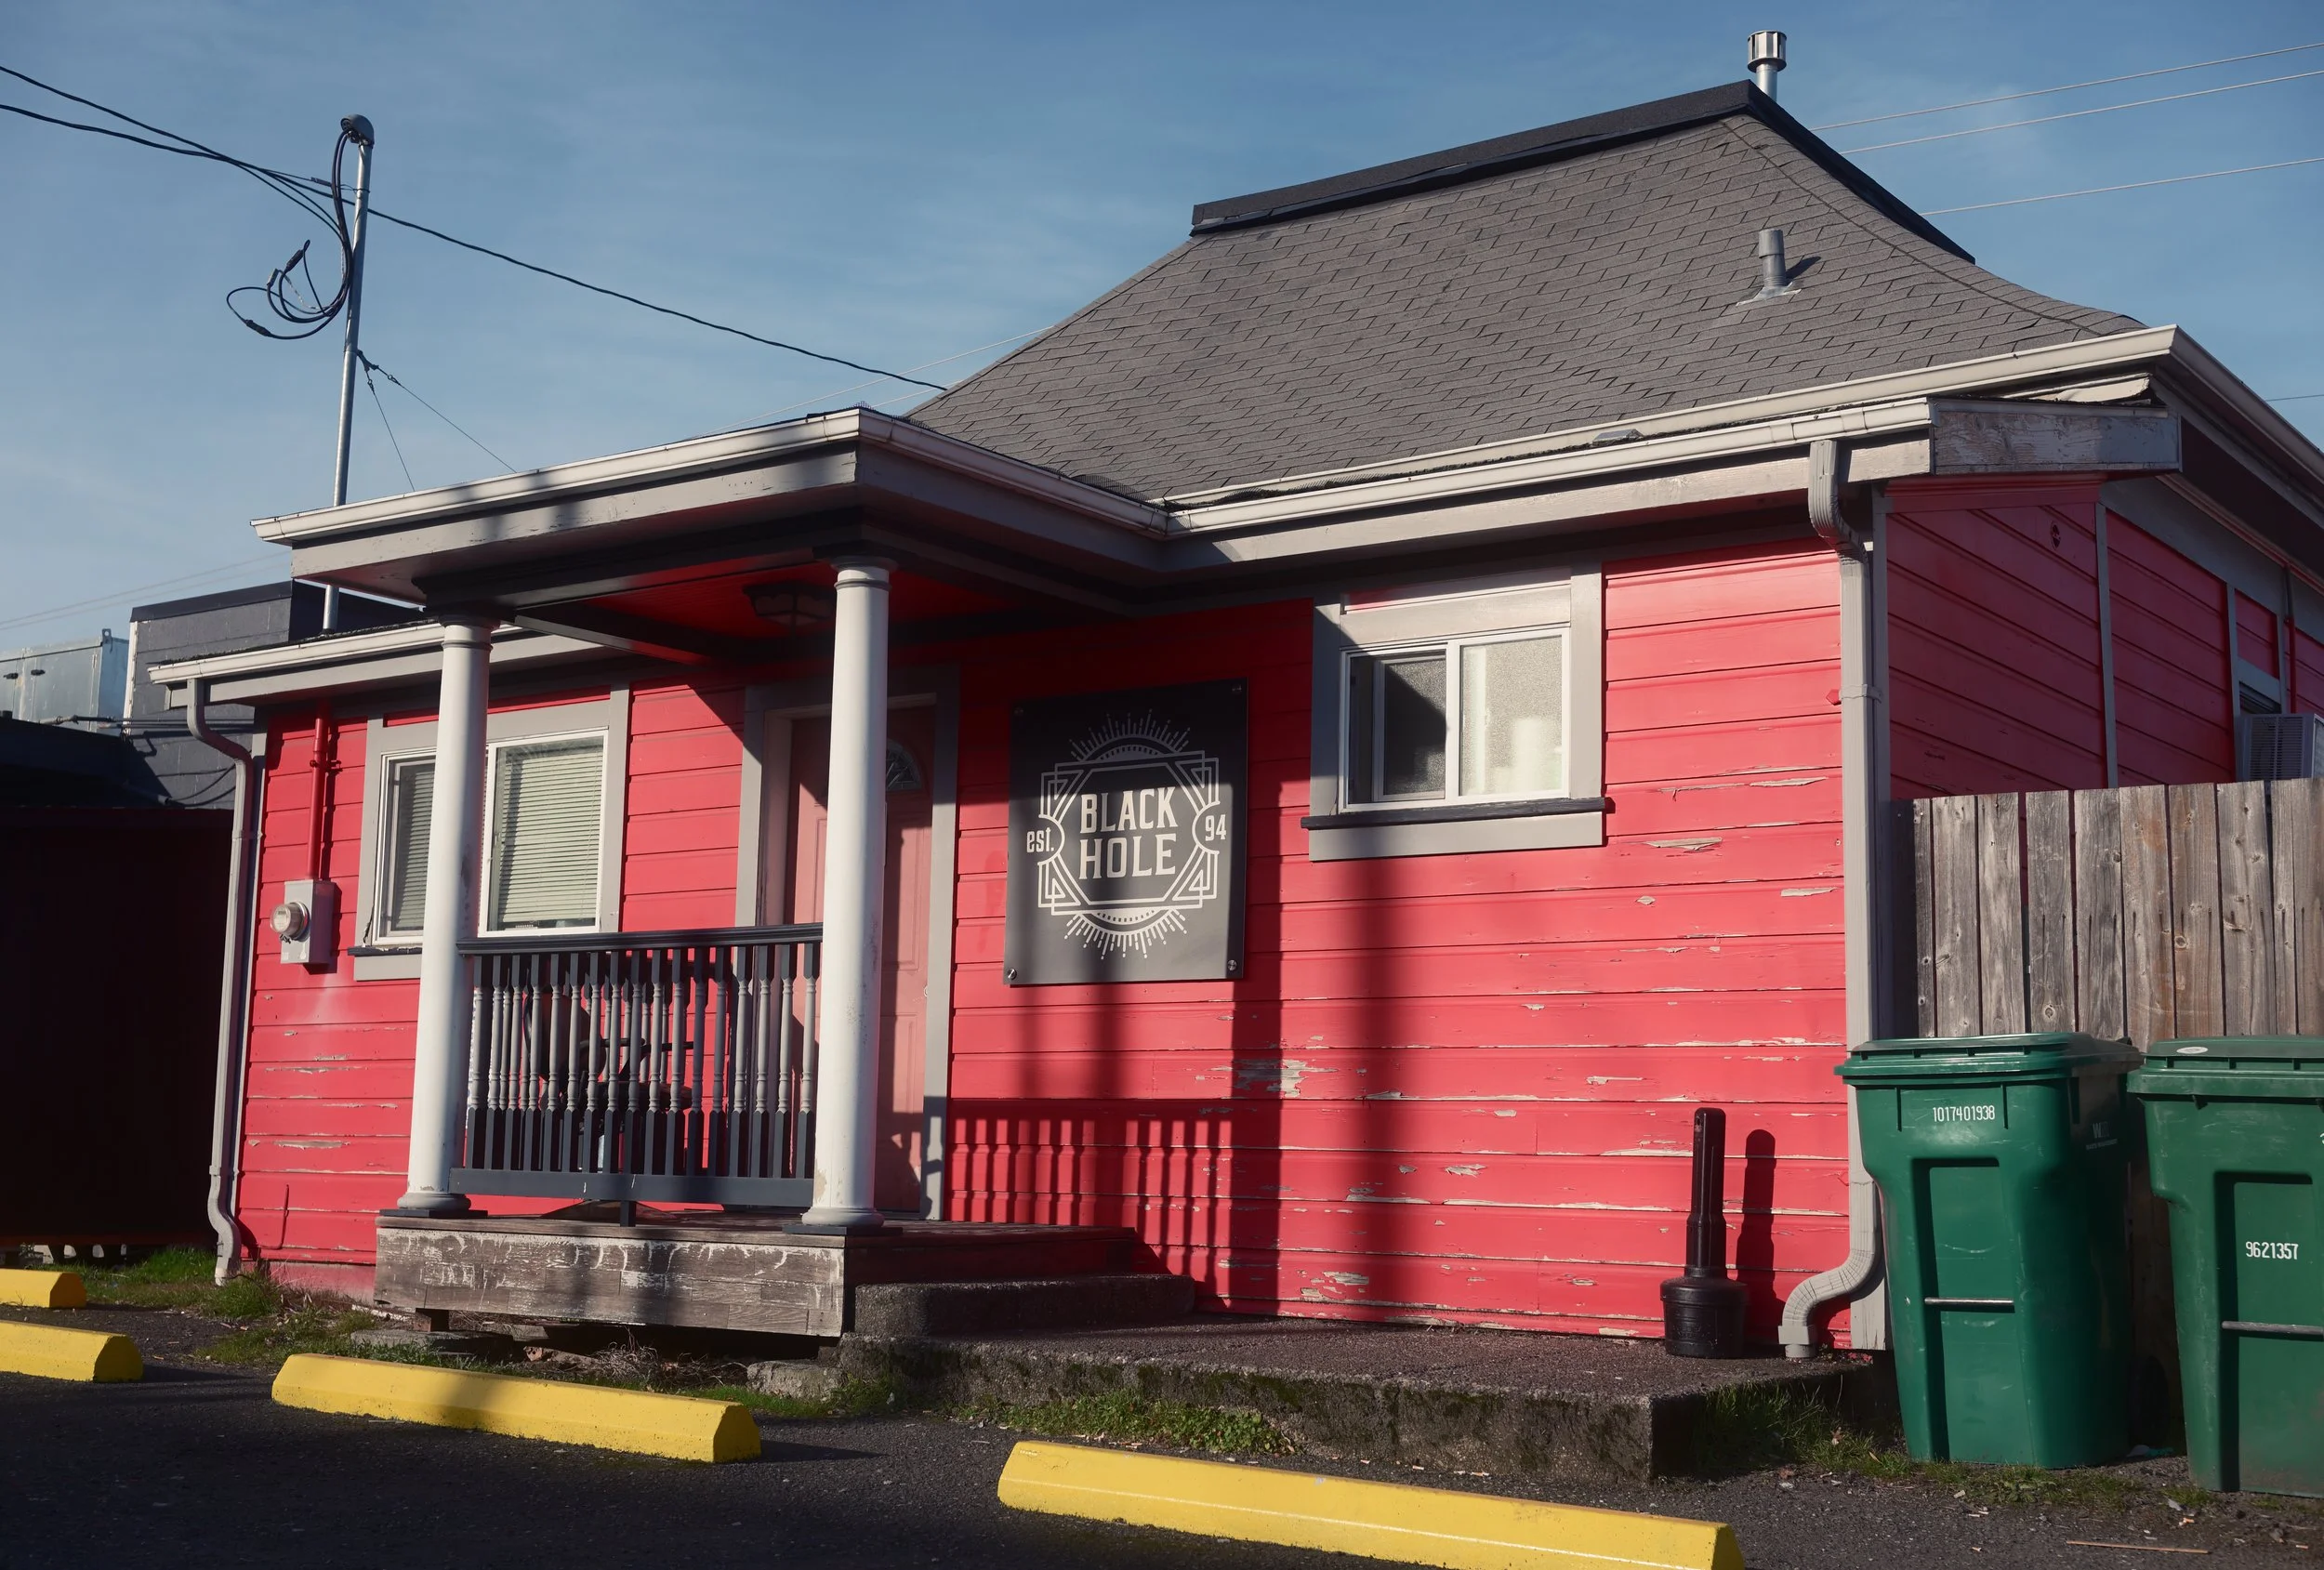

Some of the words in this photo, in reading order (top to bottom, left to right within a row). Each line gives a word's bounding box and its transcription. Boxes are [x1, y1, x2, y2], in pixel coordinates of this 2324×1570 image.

[1080, 786, 1178, 834] BLACK
[1026, 827, 1055, 853] est.
[1205, 813, 1227, 841] 94
[1078, 834, 1177, 880] HOLE
[1932, 1104, 1996, 1123] 1017401938
[2245, 1241, 2299, 1260] 9621357
